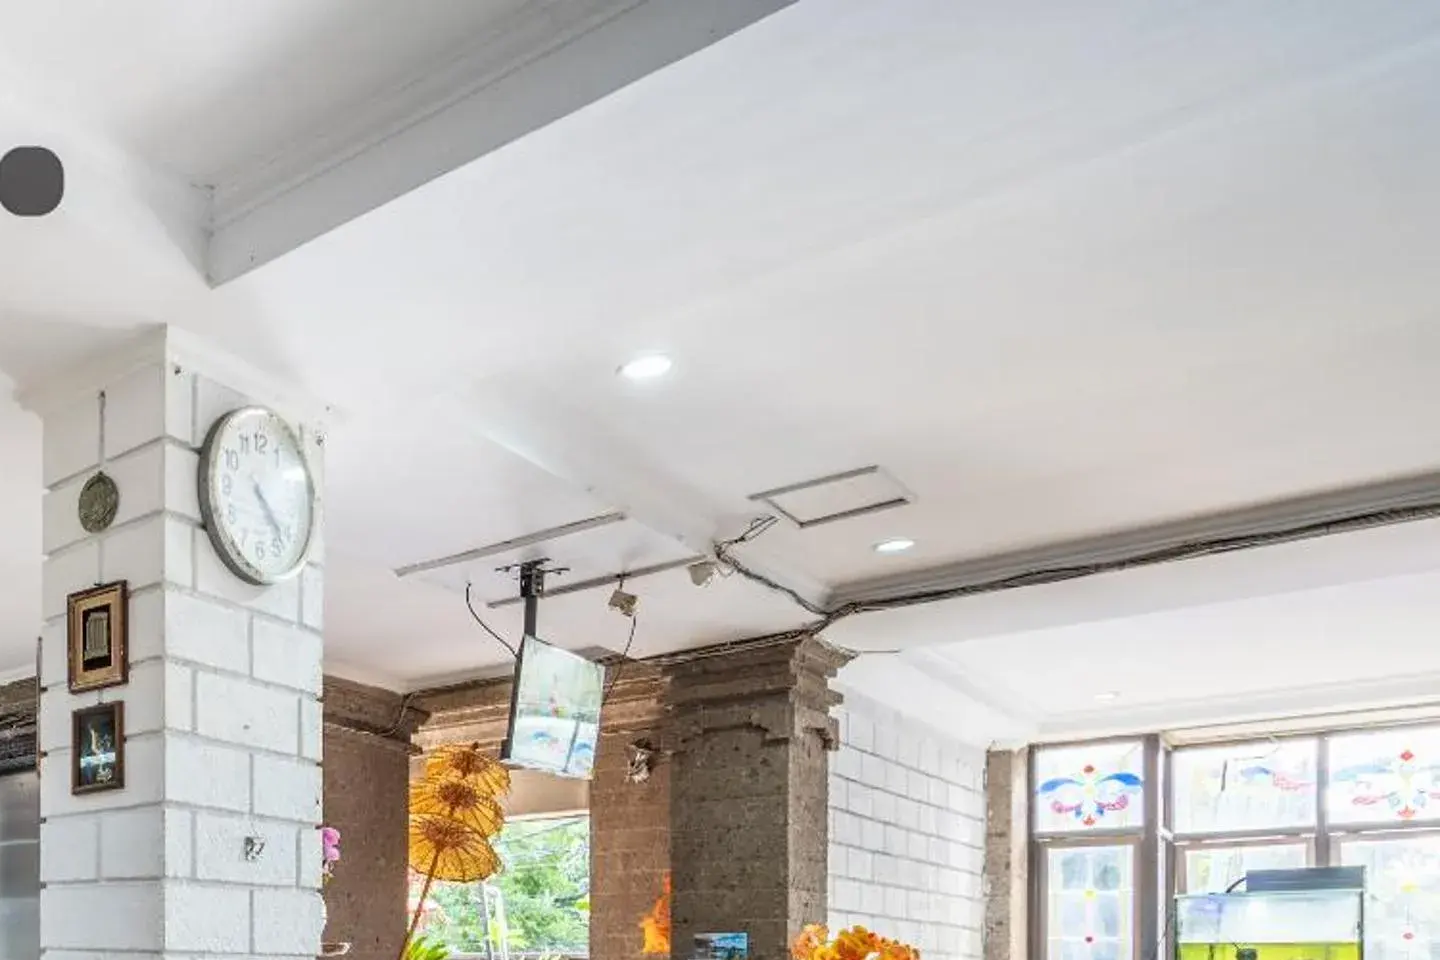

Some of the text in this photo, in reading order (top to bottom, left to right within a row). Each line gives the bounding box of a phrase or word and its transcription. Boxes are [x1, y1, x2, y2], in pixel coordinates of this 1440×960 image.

[239, 434, 250, 455] 11
[254, 432, 268, 454] 12
[225, 450, 239, 471] 10
[273, 448, 280, 470] 1
